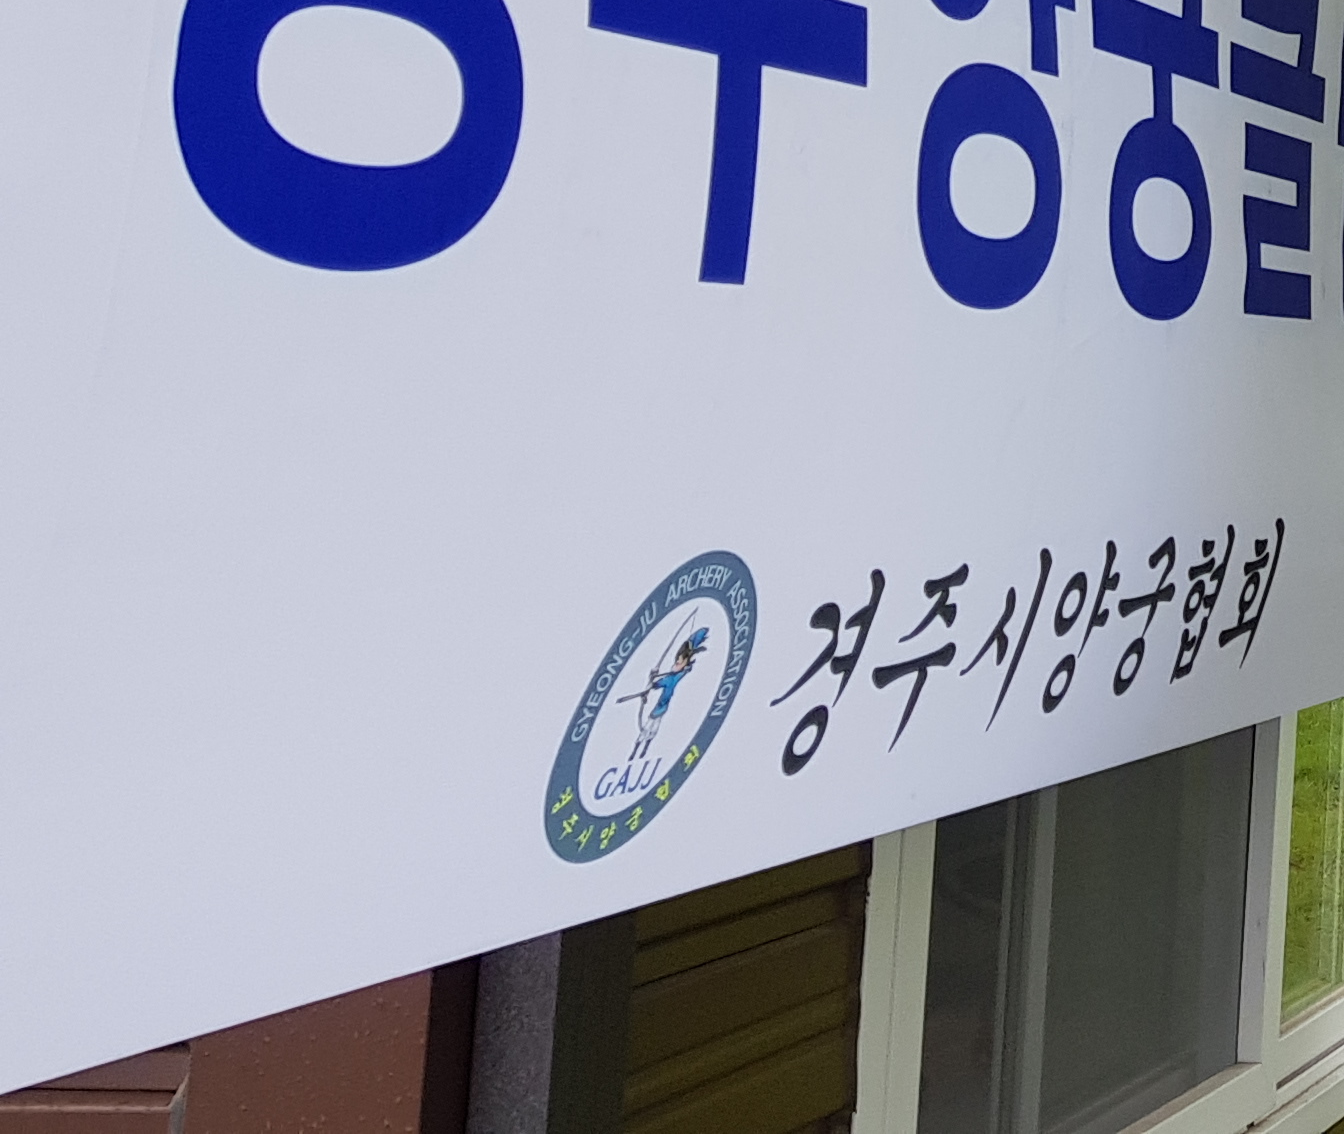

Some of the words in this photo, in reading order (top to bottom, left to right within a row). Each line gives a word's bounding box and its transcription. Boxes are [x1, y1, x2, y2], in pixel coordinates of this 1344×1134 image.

[571, 602, 657, 742] GYEONG-JU
[664, 564, 733, 608] ARCHERY
[711, 579, 750, 717] ASSOCIATION
[771, 518, 1285, 776] 경주시양궁협회
[594, 757, 662, 801] GAJJ
